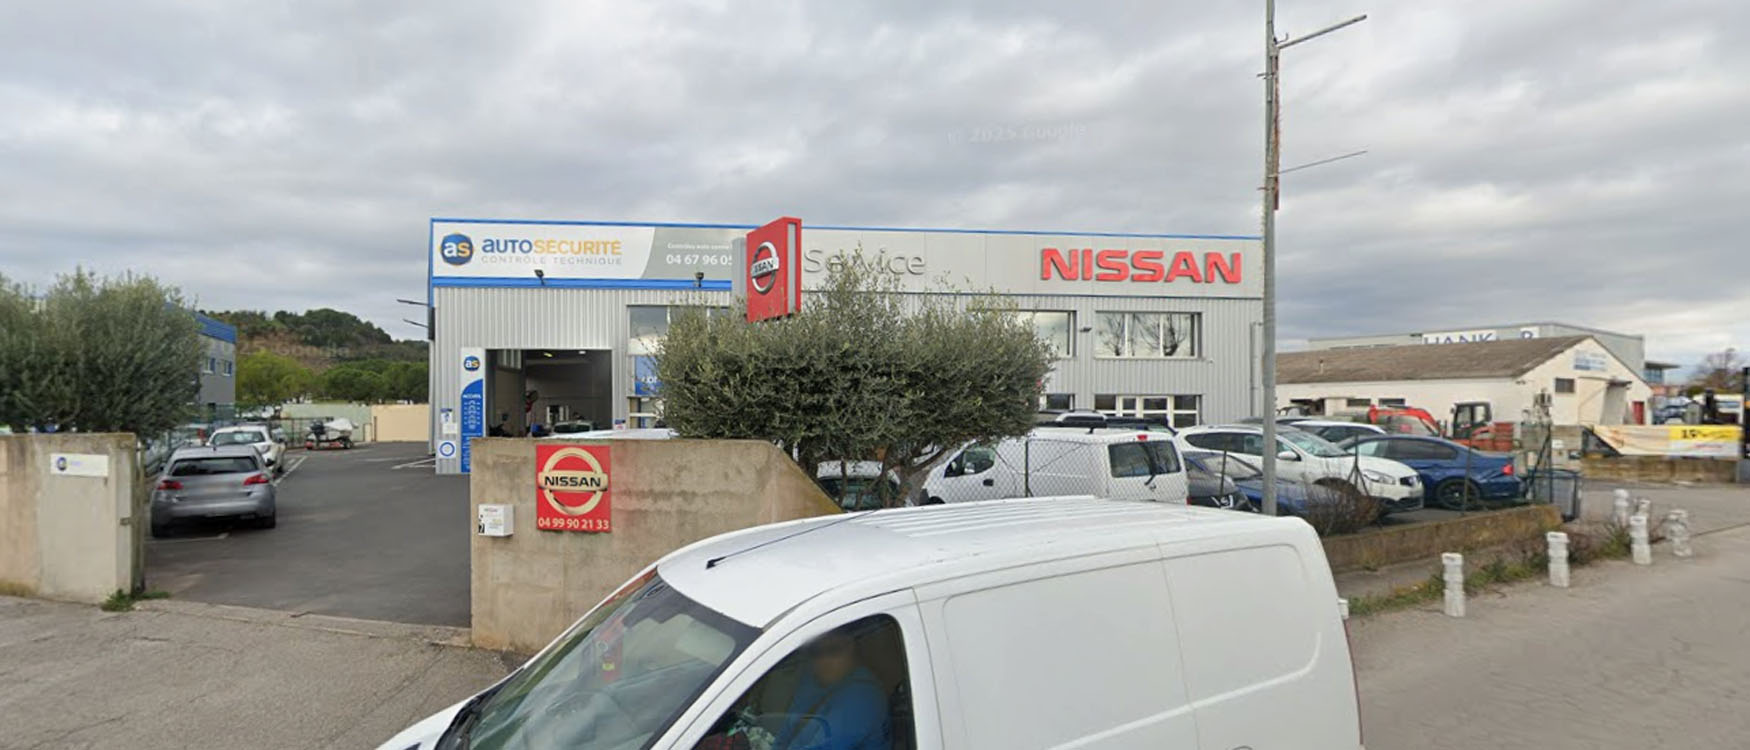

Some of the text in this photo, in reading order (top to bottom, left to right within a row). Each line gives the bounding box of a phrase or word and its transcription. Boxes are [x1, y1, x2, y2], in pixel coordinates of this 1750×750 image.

[444, 241, 471, 258] as
[553, 256, 623, 265] TECHNIQUE
[666, 254, 681, 265] 04
[684, 254, 699, 265] 67
[702, 254, 718, 265] 96
[1041, 247, 1242, 284] NISSAN
[544, 476, 602, 488] NISSAN
[538, 517, 609, 530] 04 99 90 21 33
